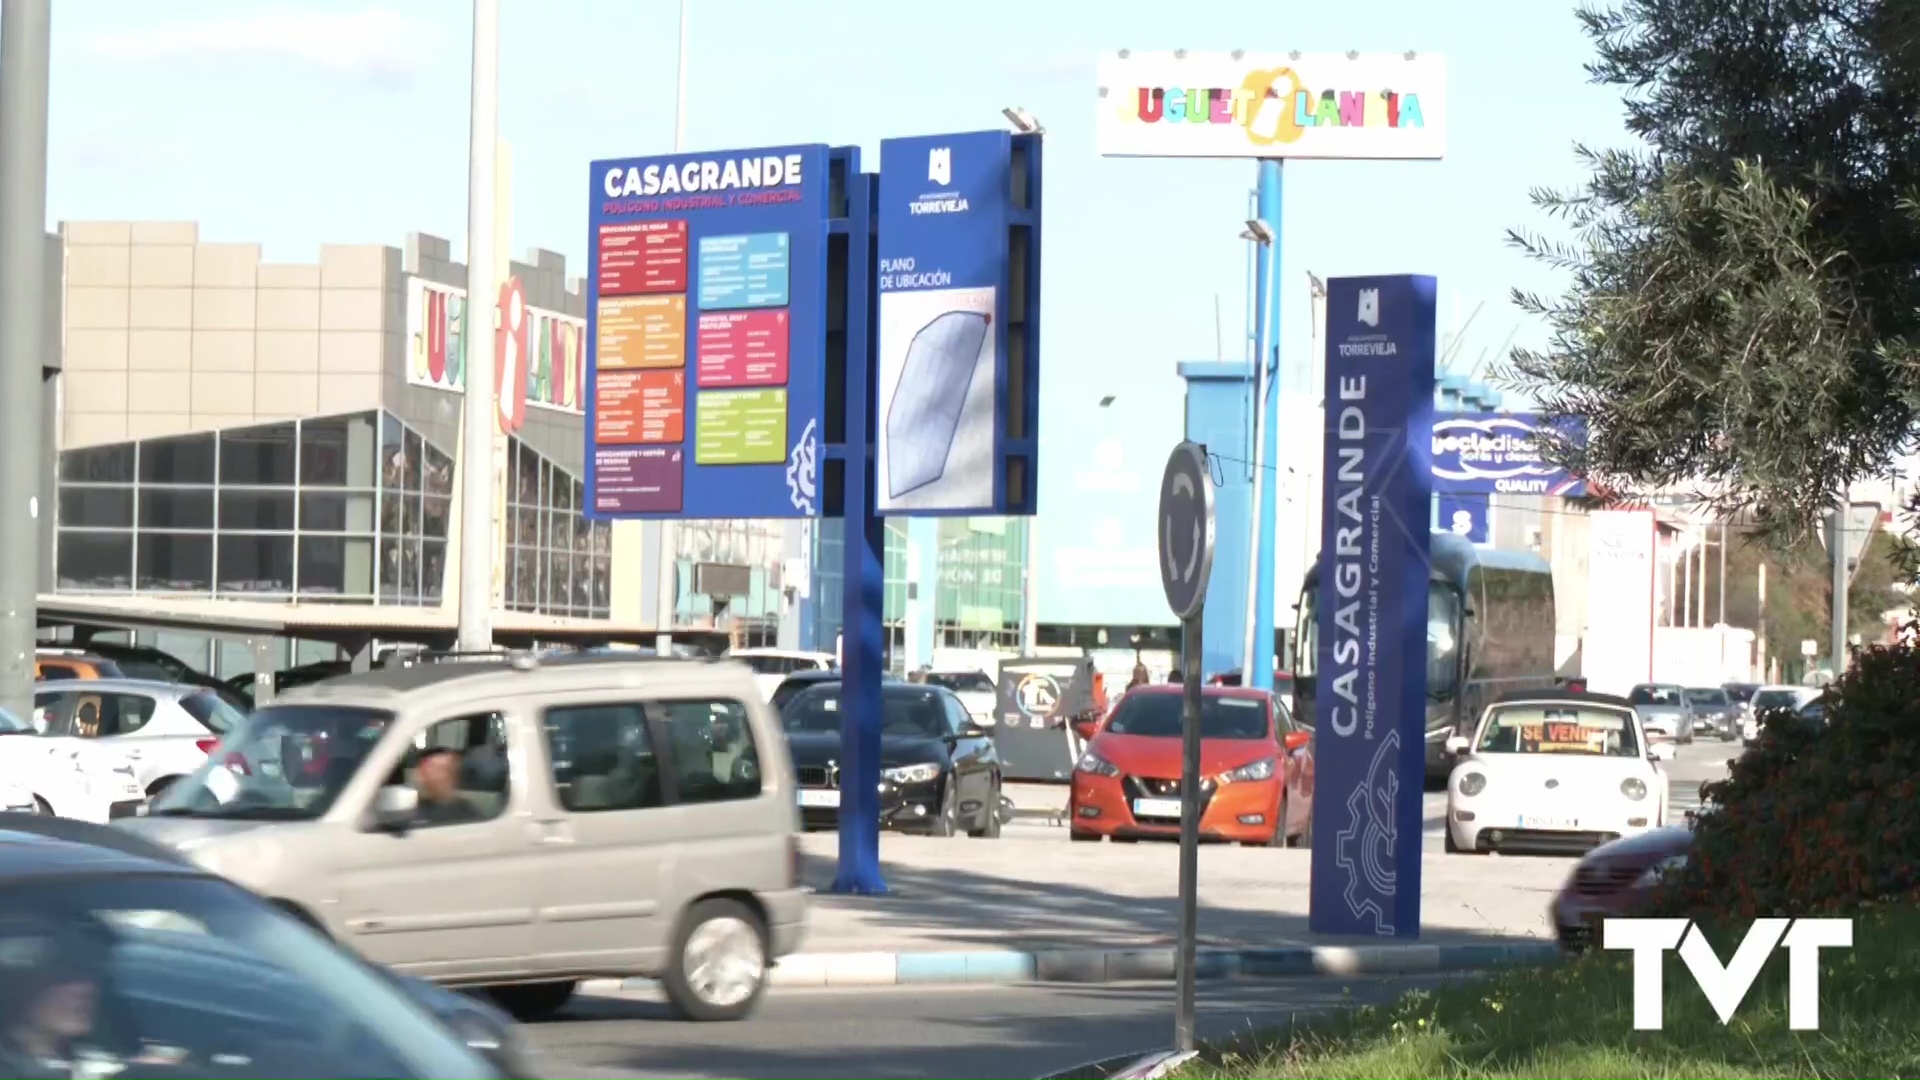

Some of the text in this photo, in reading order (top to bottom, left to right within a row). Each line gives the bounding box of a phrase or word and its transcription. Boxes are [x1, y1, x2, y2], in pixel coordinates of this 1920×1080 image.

[604, 154, 803, 199] CASAGRANDE
[662, 196, 727, 213] INDUSTRIAL
[738, 190, 803, 207] COMERCIAL
[909, 199, 969, 215] TORREVIEJA
[880, 257, 915, 272] PLANO
[881, 268, 952, 289] DE UBICACIÓN
[1339, 342, 1397, 357] TORREVIEJA
[1495, 479, 1548, 493] QUALITY
[1369, 495, 1381, 574] Comercial
[1331, 374, 1367, 738] CASAGRANDE
[1366, 591, 1379, 666] Industrial
[1364, 670, 1376, 740] Polígono
[1523, 725, 1544, 740] SE
